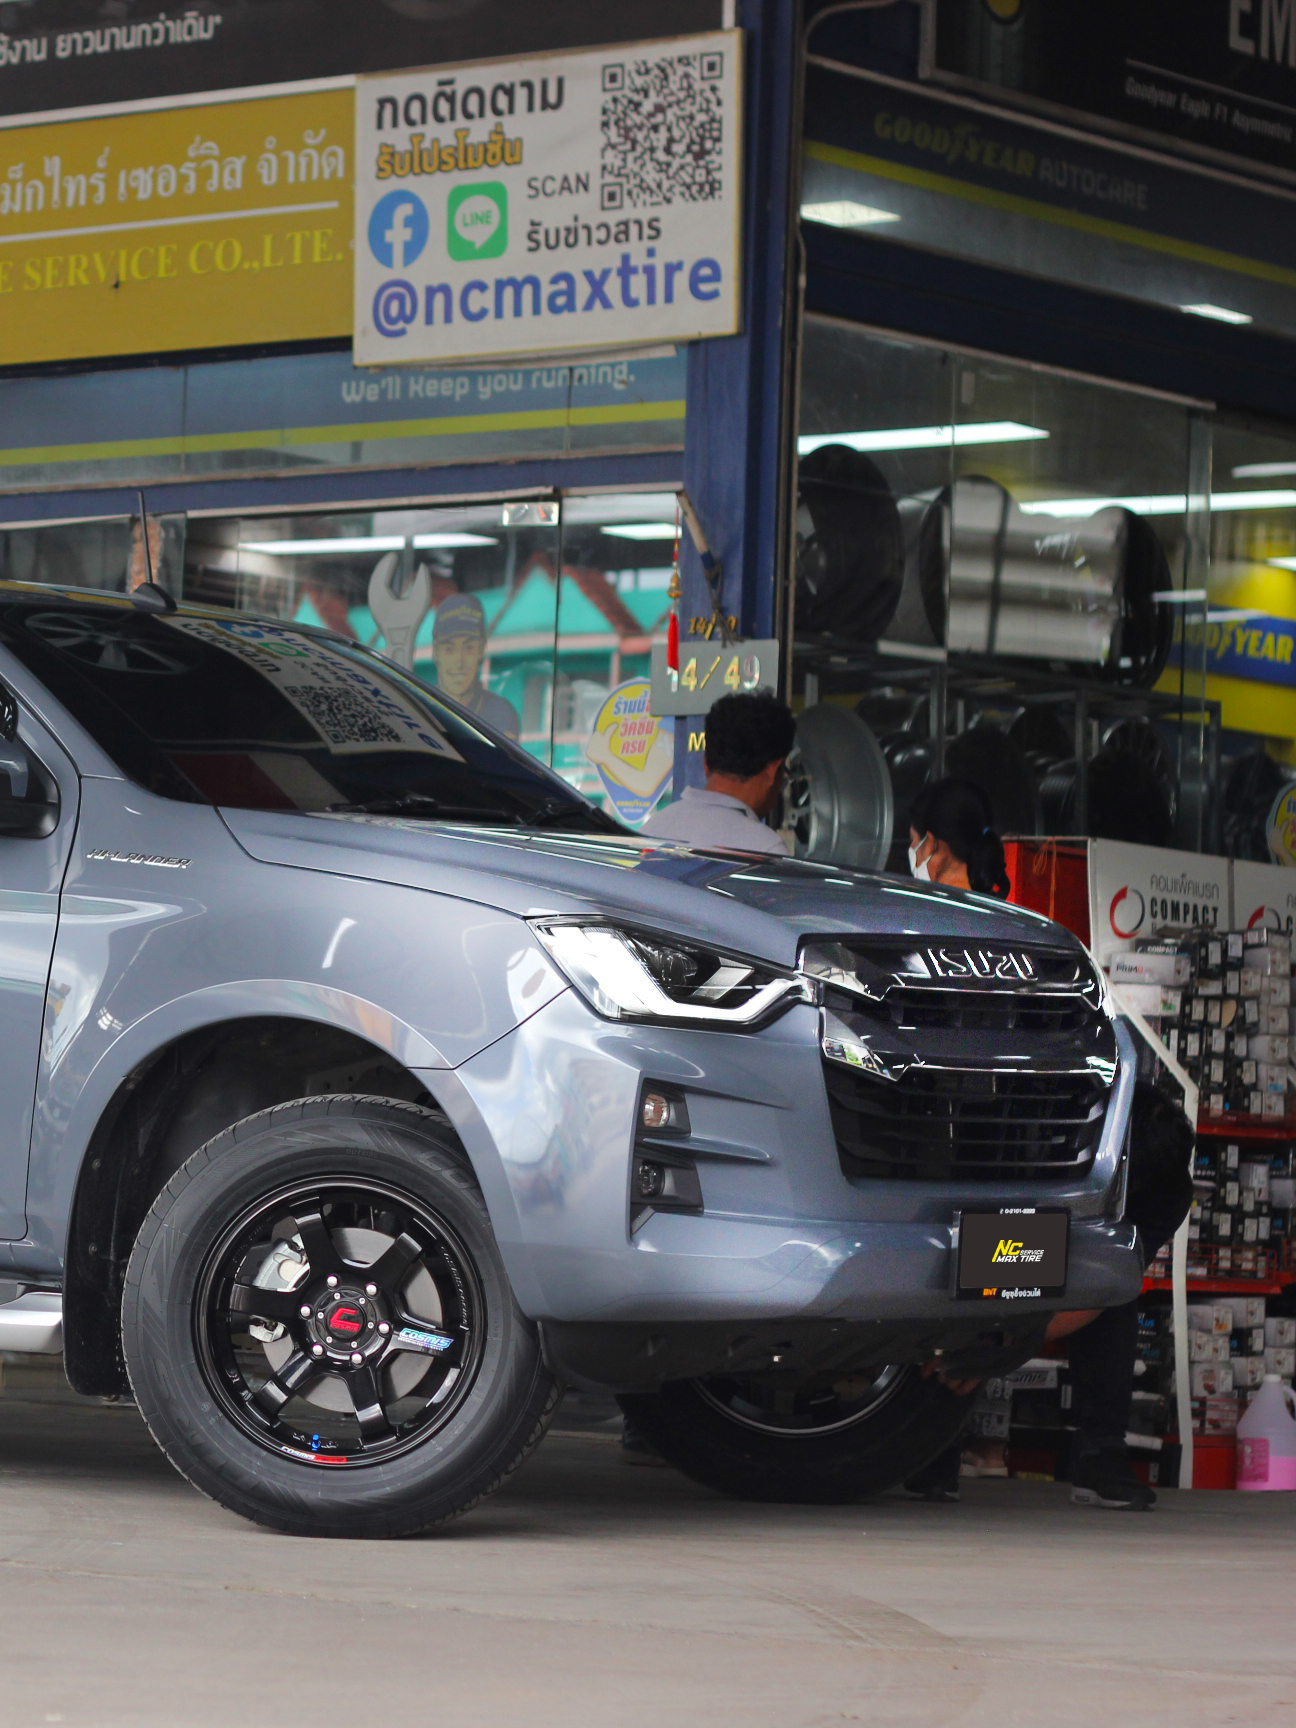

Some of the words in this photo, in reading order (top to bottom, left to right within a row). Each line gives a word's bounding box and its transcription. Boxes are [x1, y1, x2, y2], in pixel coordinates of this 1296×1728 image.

[375, 76, 566, 131] กดติดตาม
[118, 135, 247, 203] เซอร์วิส
[256, 128, 346, 187] จำกัด
[375, 122, 524, 181] รับโปรโมชั่น
[873, 110, 1036, 179] GOODYEAR
[1038, 158, 1149, 211] AUTOCARE
[526, 170, 592, 200] SCAN
[461, 208, 494, 229] LINE
[526, 212, 663, 253] รับข่าวสาร
[23, 243, 179, 293] SERVICE
[371, 246, 724, 339] @ncmaxtire
[341, 373, 402, 404] We'll
[478, 370, 525, 400] you
[531, 362, 636, 391] running.
[666, 655, 761, 693] 14/49
[620, 739, 648, 756] ครบ
[1149, 897, 1220, 926] COMPACT
[926, 947, 1040, 982] ISUZU
[400, 1329, 452, 1348] COSMIS
